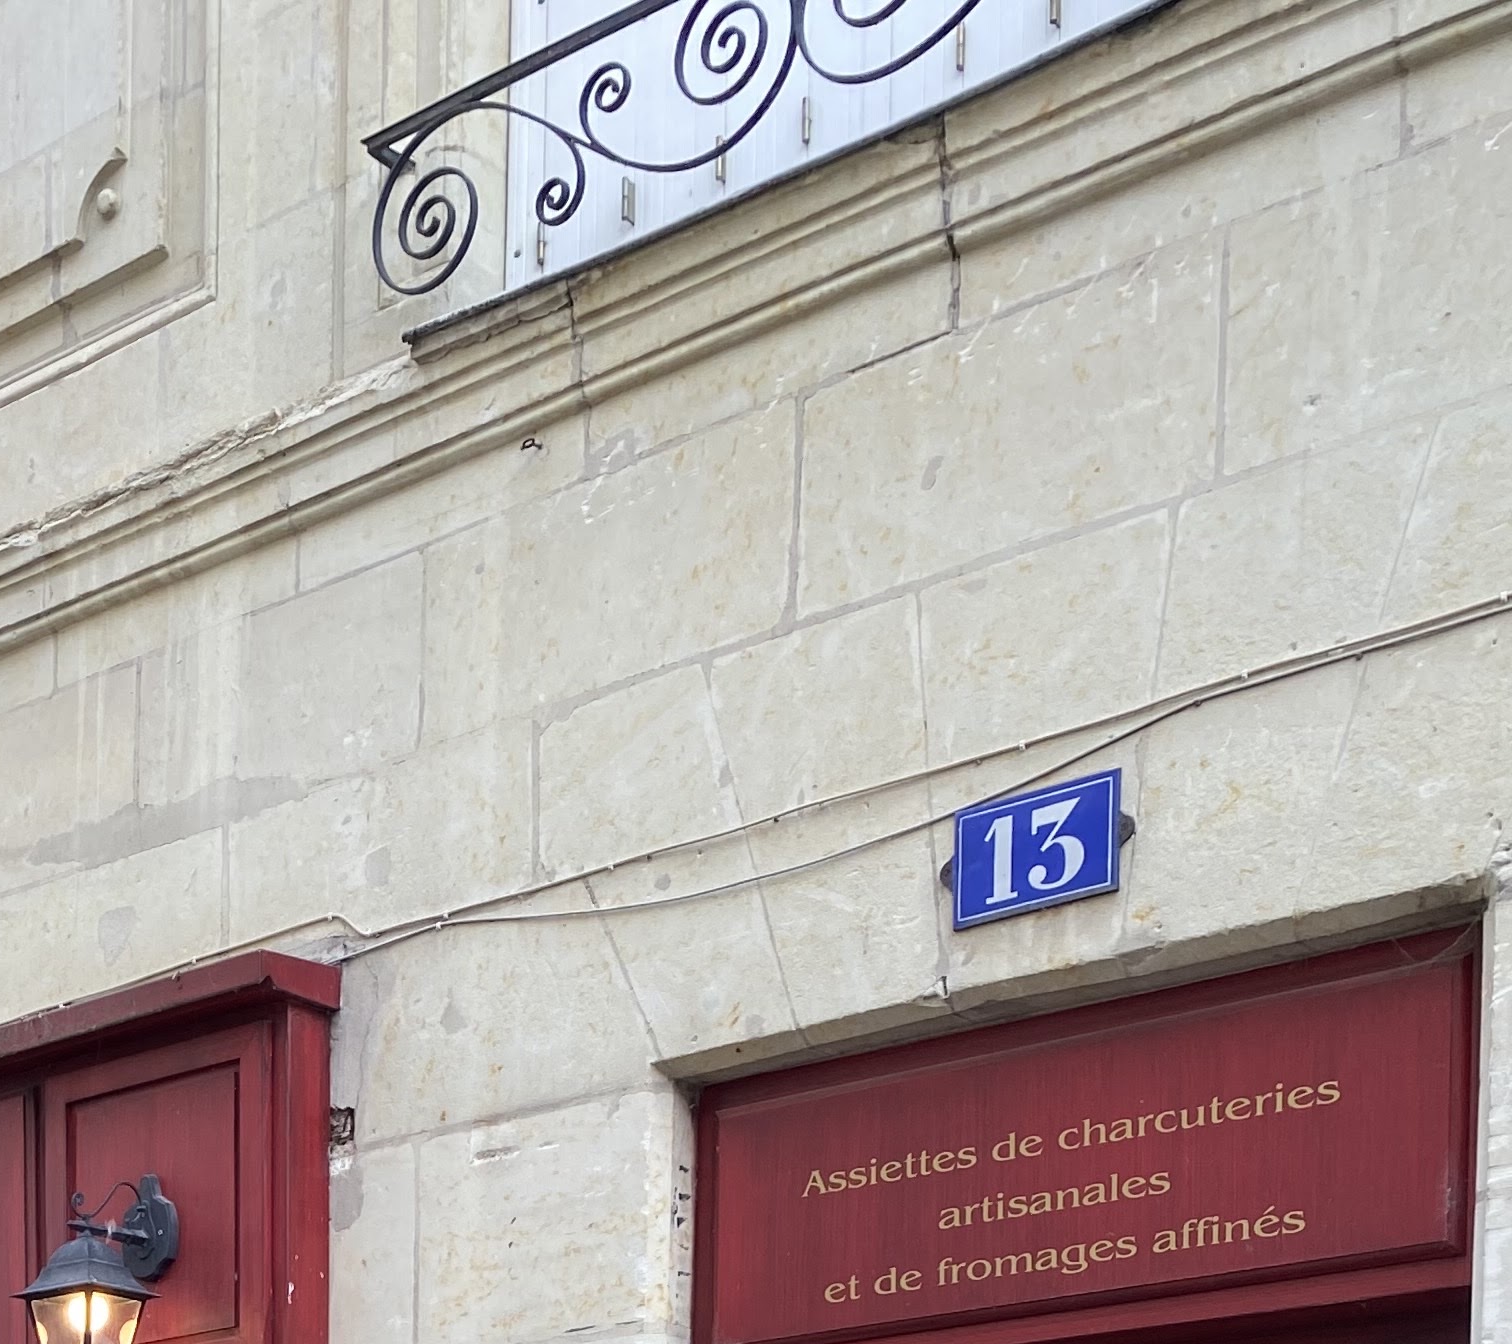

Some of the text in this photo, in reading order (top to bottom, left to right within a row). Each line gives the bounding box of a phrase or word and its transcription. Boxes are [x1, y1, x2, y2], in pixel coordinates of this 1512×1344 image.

[983, 796, 1086, 905] 13
[802, 1077, 1342, 1198] Assiettes de charcuteries
[937, 1167, 1172, 1232] artisanales
[823, 1205, 1307, 1304] et de fromages affinés
